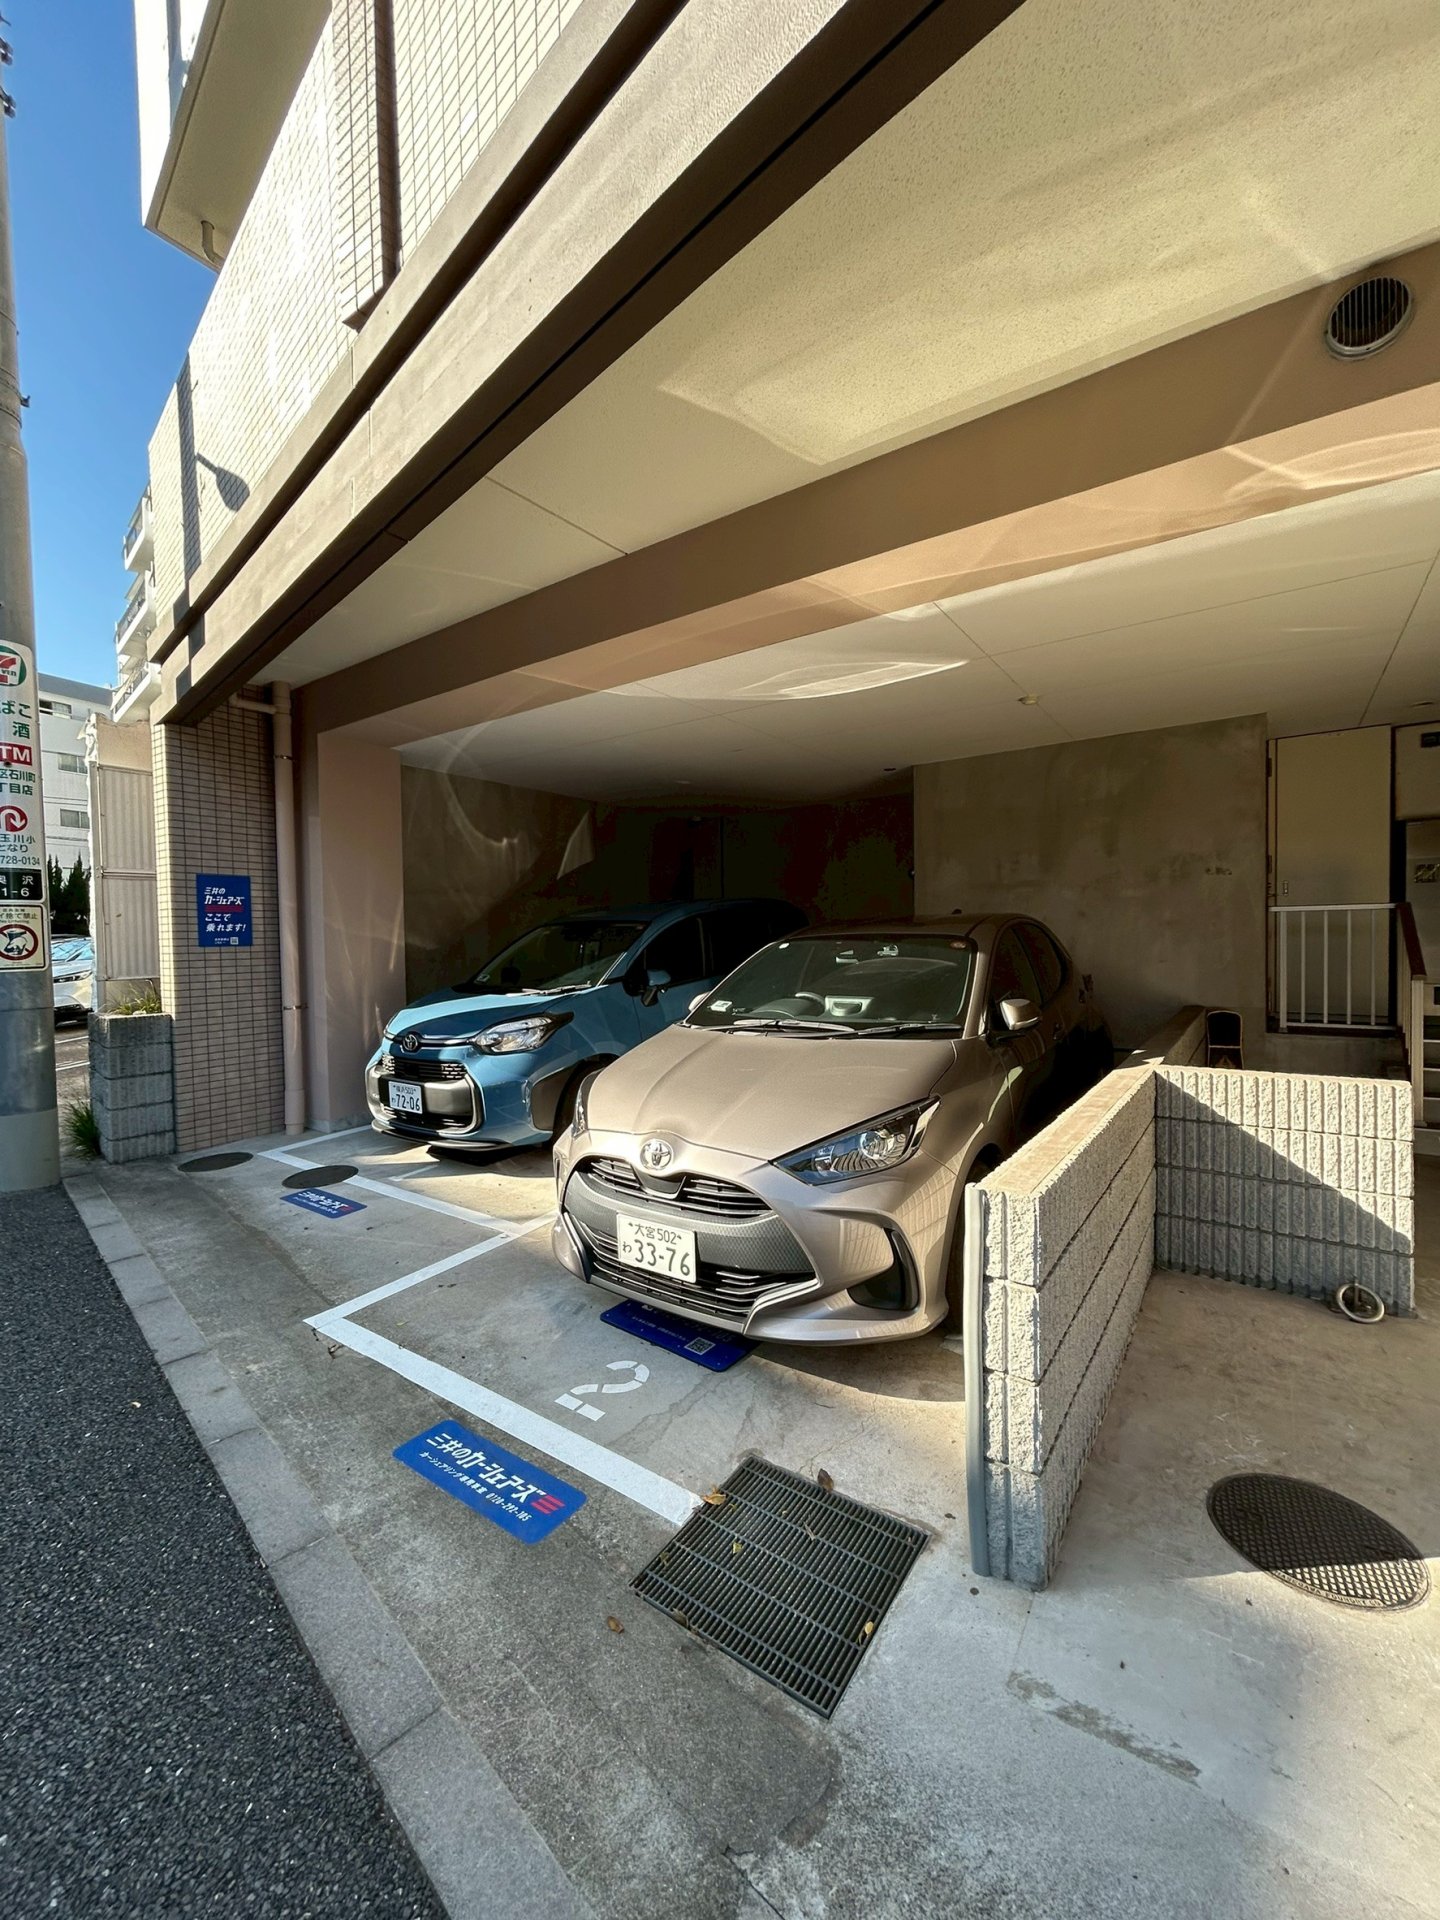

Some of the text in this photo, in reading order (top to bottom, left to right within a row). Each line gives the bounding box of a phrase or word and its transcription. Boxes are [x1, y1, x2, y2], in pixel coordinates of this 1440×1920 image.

[12, 721, 31, 740] 酒
[1, 886, 30, 897] 1-6
[204, 886, 226, 895] 三井の
[205, 913, 231, 921] ここで
[622, 1239, 691, 1276] わ 33-76
[426, 1433, 548, 1503] 三井のカーシェアーズ
